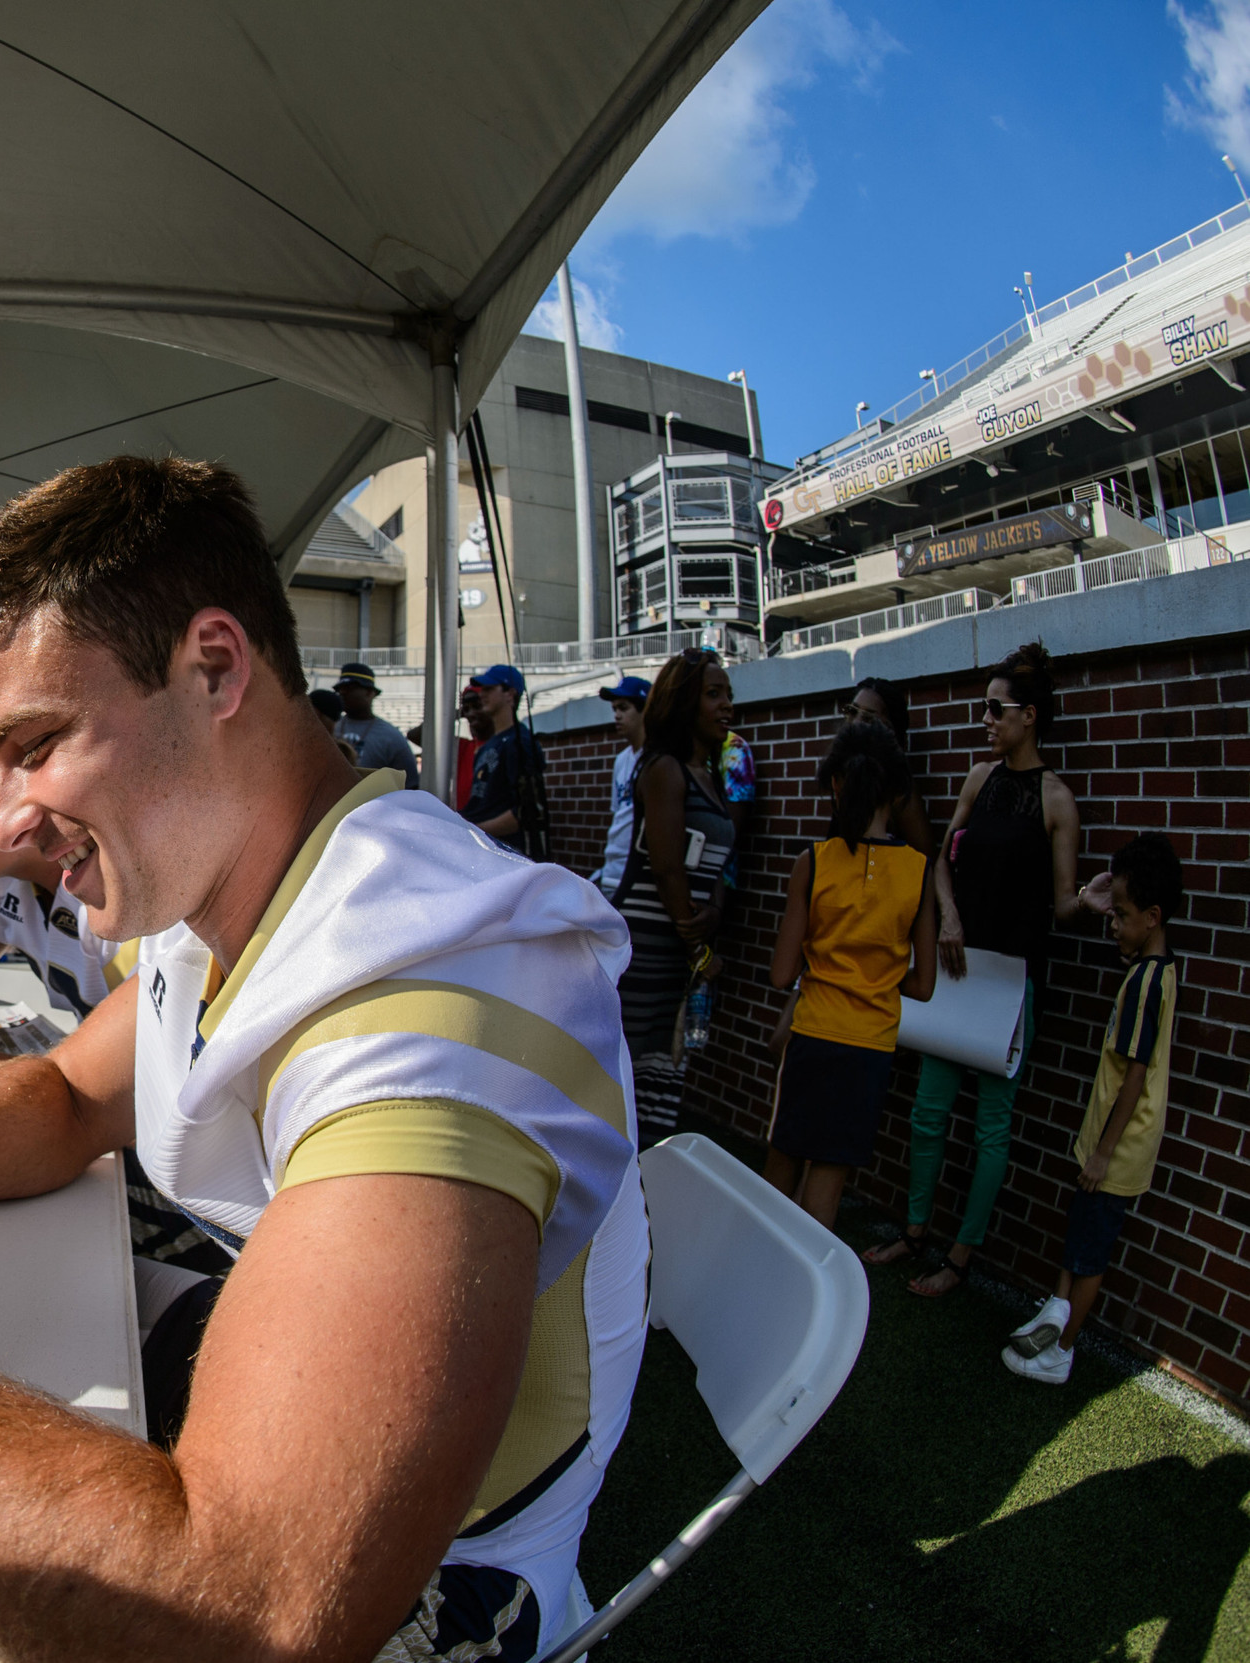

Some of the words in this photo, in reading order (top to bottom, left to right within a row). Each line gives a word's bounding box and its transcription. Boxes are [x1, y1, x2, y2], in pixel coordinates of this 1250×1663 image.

[1161, 315, 1195, 345] BILLY
[1169, 320, 1229, 366] SHAW
[976, 404, 997, 425] JOE
[981, 402, 1042, 443] GUYON
[829, 450, 895, 482] PROFESSIONAL
[897, 425, 945, 451] FOOTBALL
[833, 470, 875, 504] HALL
[876, 462, 899, 485] OF
[902, 437, 952, 477] FAME
[793, 484, 822, 513] GT
[929, 534, 978, 563] YELLOW
[982, 520, 1043, 551] JACKETS
